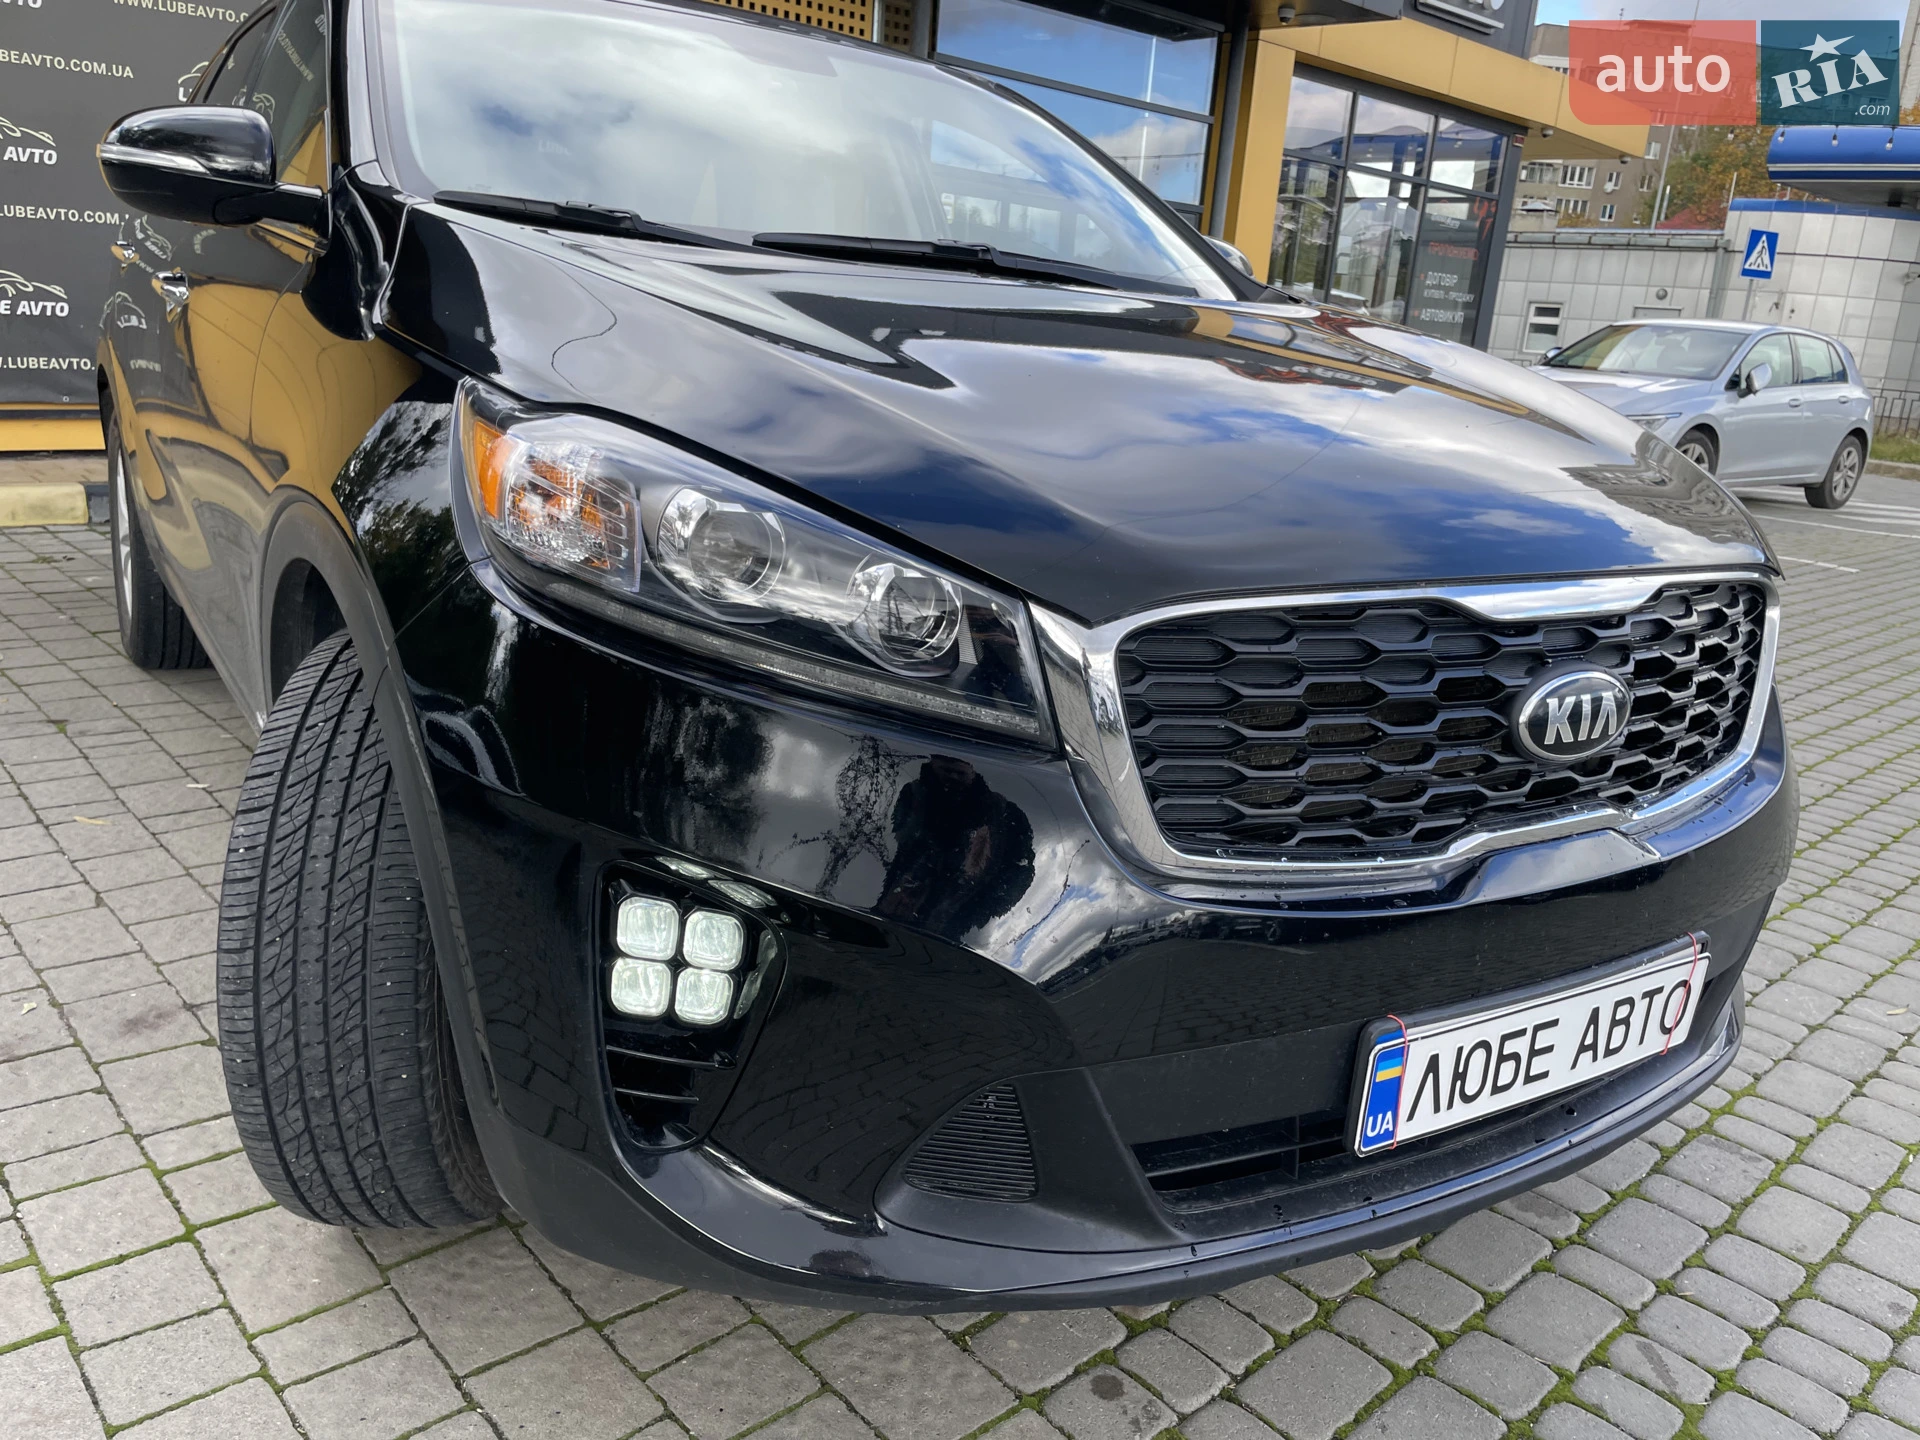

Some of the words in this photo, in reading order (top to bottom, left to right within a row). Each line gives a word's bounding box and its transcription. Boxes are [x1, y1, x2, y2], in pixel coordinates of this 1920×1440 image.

[3, 146, 58, 165] AVTO
[16, 300, 69, 317] AVTO
[0, 356, 96, 371] .LUBEAVTO.
[1544, 691, 1618, 745] KIA
[1406, 1018, 1560, 1123] ЛЮБЕ
[1570, 979, 1692, 1071] АВТО
[1366, 1110, 1394, 1138] UA
